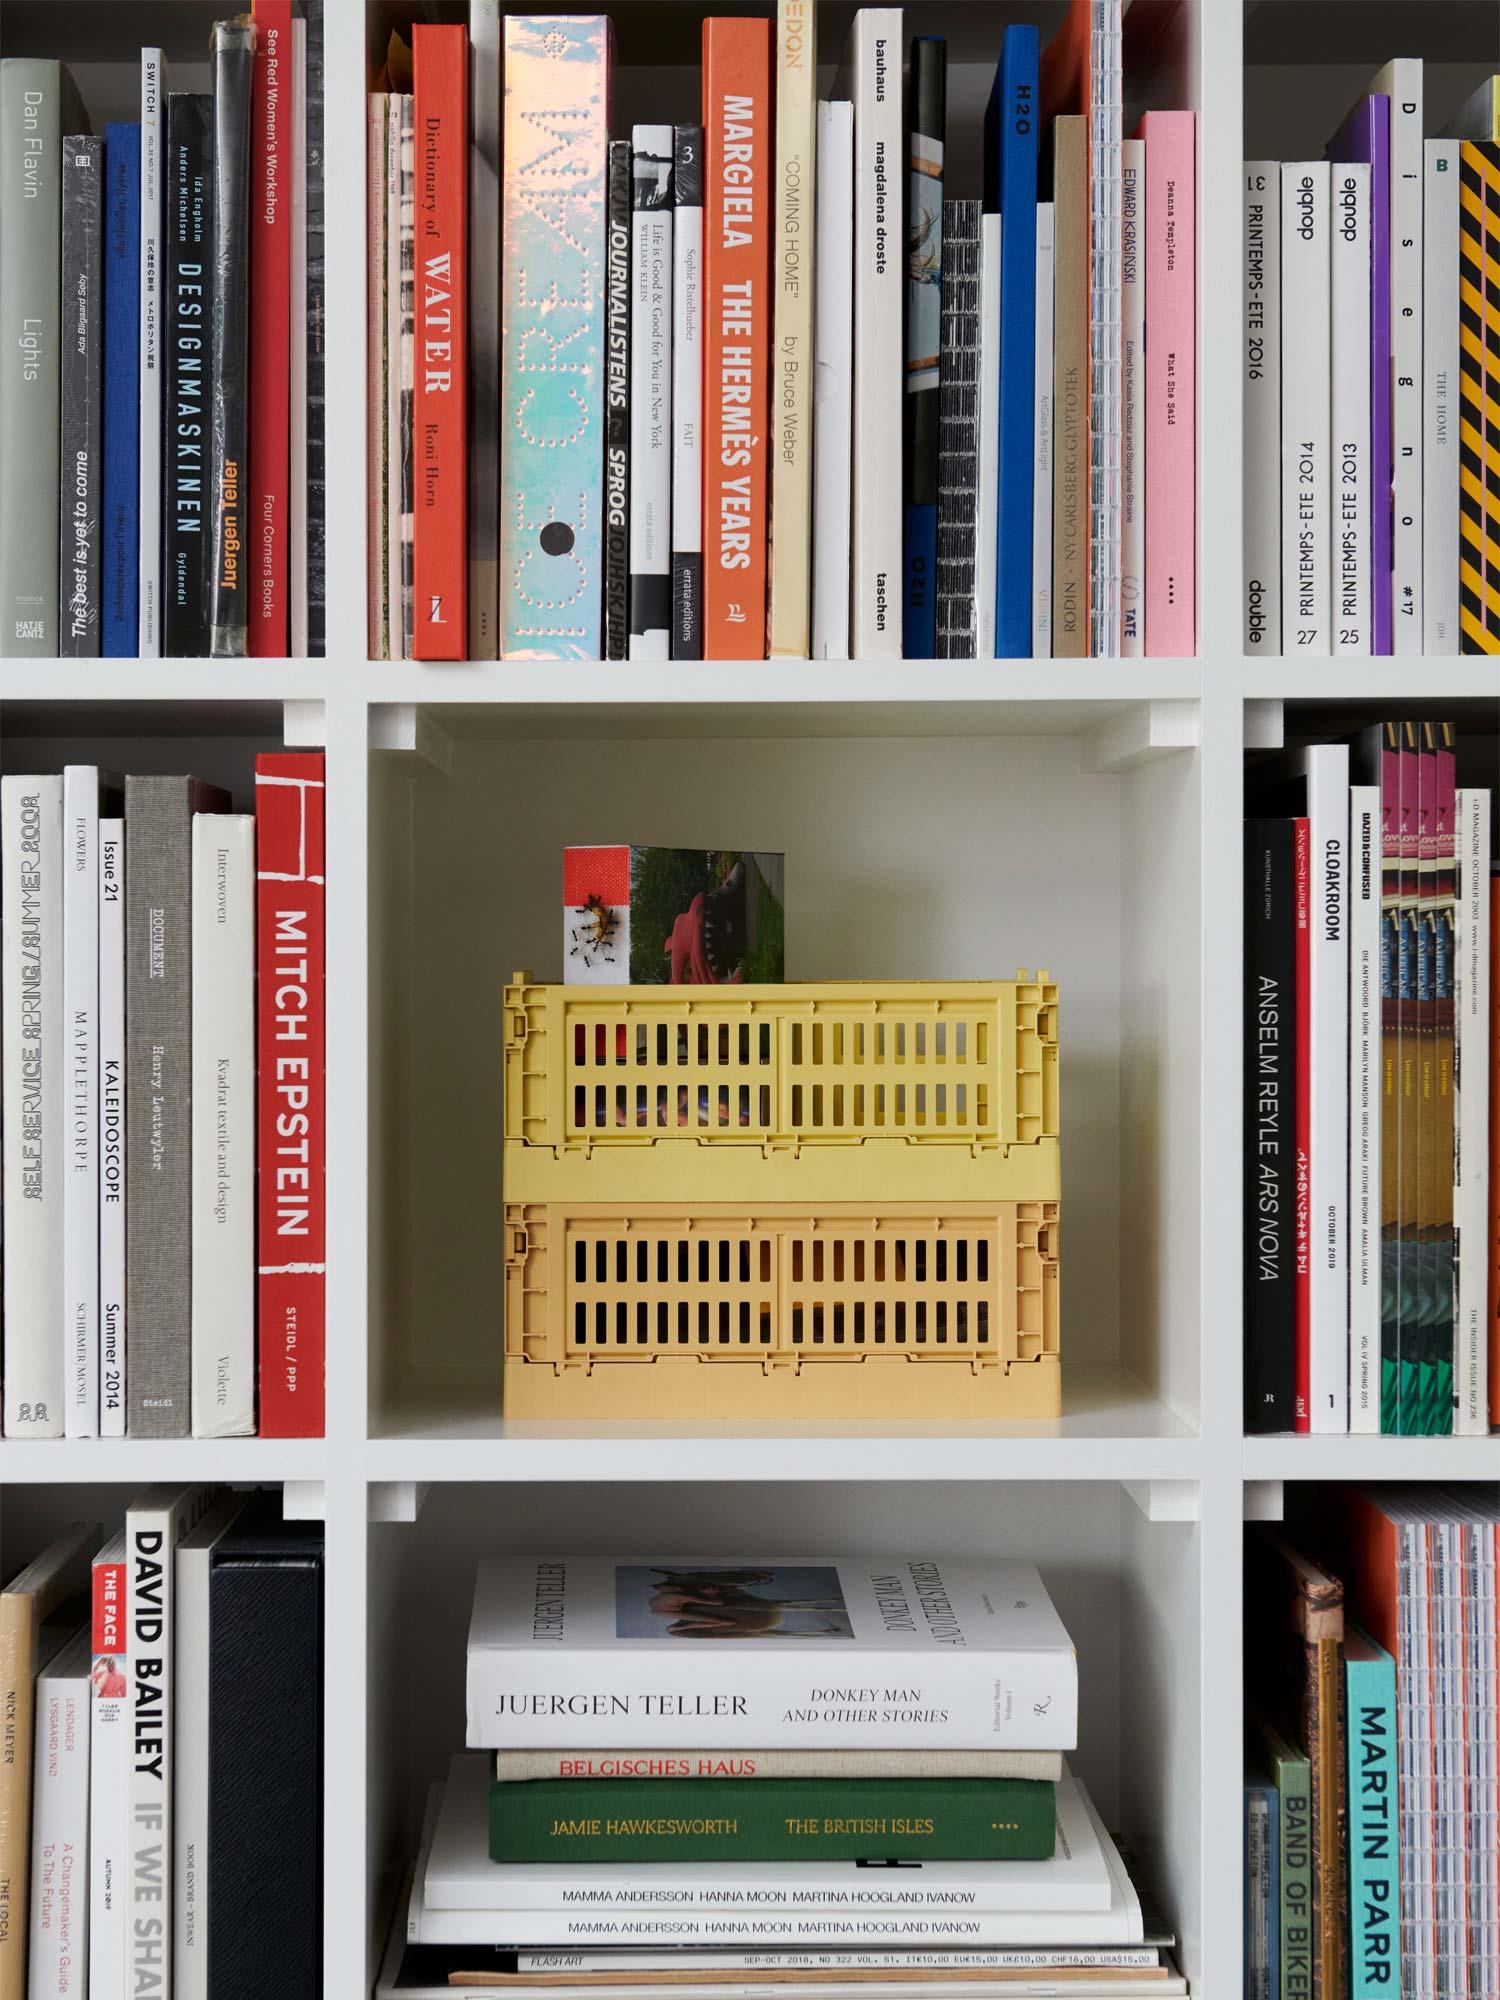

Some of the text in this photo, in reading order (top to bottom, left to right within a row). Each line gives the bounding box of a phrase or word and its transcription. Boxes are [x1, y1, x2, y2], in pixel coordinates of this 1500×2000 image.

[147, 63, 155, 112] SWITCH
[263, 29, 278, 224] See Red Women’s Workshop
[874, 40, 887, 274] bauhaus magdalena droste
[180, 146, 188, 241] Anders Michelsen
[193, 177, 203, 241] Ida Engholm
[785, 155, 800, 298] “COMING HOME”
[1123, 168, 1138, 284] EDWARD KRASIŃSKI
[1166, 181, 1175, 271] Deanna Templeton
[1297, 177, 1313, 240] double
[1340, 178, 1356, 241] double
[19, 90, 44, 381] Dan Flavin Lights
[640, 224, 648, 268] WILLIAM
[653, 225, 663, 244] Life
[652, 260, 663, 289] Good
[653, 293, 662, 304] &
[684, 248, 696, 341] Sophie Ristelhueber
[1249, 206, 1264, 379] PRINTEMPS-ETE 2016
[422, 118, 451, 506] Dictionary of WATER Roni Horn
[608, 220, 629, 408] JOURNALISTENS
[653, 308, 663, 337] Good
[720, 96, 760, 568] MARGIELA THE HERMÈS YEARS
[652, 360, 662, 379] You
[653, 342, 663, 356] for
[178, 264, 201, 531] DESIGNMASKINEN
[652, 384, 661, 393] in
[652, 398, 662, 421] New
[781, 337, 798, 466] by Bruce Weber
[1437, 372, 1446, 444] THE HOME
[652, 425, 662, 448] York
[682, 424, 693, 448] FAIT
[608, 448, 629, 526] SPROG
[71, 451, 90, 637] The best is yet to come
[220, 458, 242, 590] Juergen Teller
[264, 495, 274, 617] Four Corners Books
[1299, 442, 1314, 615] PRINTEMPS-ETE 2014
[1343, 444, 1357, 615] PRINTEMPS-ETE 2013
[176, 553, 186, 604] Gyldendal
[877, 573, 887, 630] taschen
[1249, 580, 1266, 643] double
[16, 621, 44, 629] HATJE
[1124, 607, 1137, 638] TATE
[1298, 631, 1317, 644] 27
[1340, 630, 1358, 644] 25
[77, 818, 85, 871] FLOWERS
[1326, 840, 1340, 940] CLOAKROOM
[150, 908, 165, 979] DOCUMENT
[149, 1046, 166, 1169] Henry Leutwyler
[276, 911, 308, 1234] MITCH EPSTEIN
[105, 842, 119, 1409] Issue 21 KALEIDOSCOPE Summer 2014
[215, 849, 230, 1405] Interwoven Kvadrat textile and design Violette
[1259, 976, 1278, 1280] ANSELM REYLE ARS NOVA
[287, 1307, 296, 1351] STEIDL
[287, 1367, 296, 1391] PPP
[105, 1571, 118, 1646] THE FACE
[136, 1532, 162, 1642] DAVID
[532, 1562, 566, 1642] JUERGEN TELLER
[870, 1575, 918, 1632] DONKEY MAN
[907, 1562, 968, 1646] AND OTHER STORIES
[3, 1690, 16, 1765] NICK MEYER
[65, 1698, 76, 1751] LENDAGER
[136, 1659, 162, 1779] BAILEY
[496, 1695, 747, 1714] JUERGEN TELLER
[783, 1710, 948, 1722] AND OTHER STORIES
[812, 1690, 920, 1701] DONKEY MAN
[49, 1698, 60, 1776] LYSGAARD VIND
[558, 1758, 757, 1778] BELGISCHES HAUS
[133, 1802, 162, 1830] IF
[551, 1818, 933, 1835] JAMIE HAWKESWORTH THE BRITISH ISLES
[1361, 1708, 1390, 1984] MARTIN PARR
[40, 1842, 56, 1930] To The Future
[133, 1844, 162, 1904] WE
[530, 1955, 585, 1968] FLASH ART
